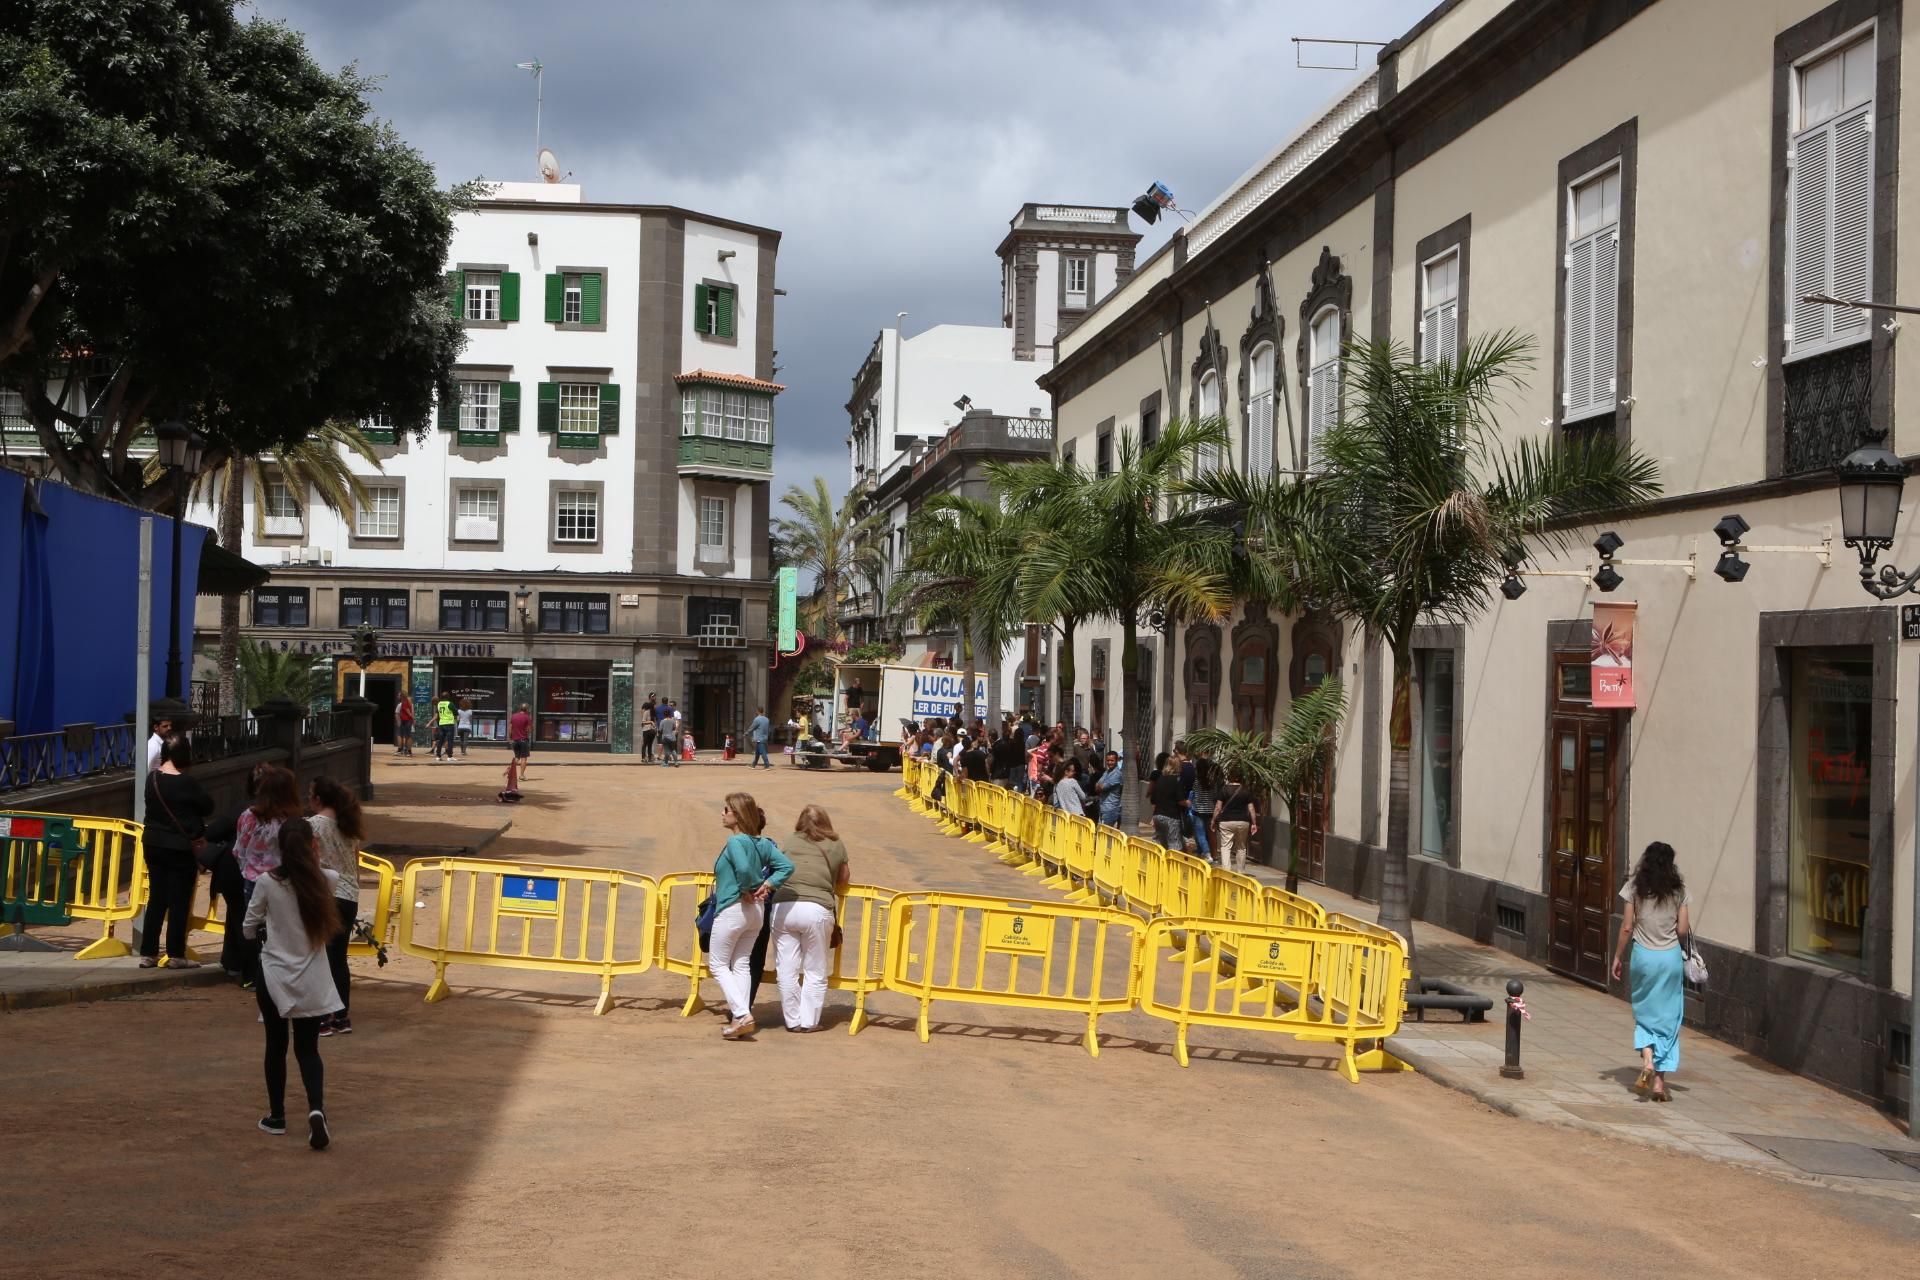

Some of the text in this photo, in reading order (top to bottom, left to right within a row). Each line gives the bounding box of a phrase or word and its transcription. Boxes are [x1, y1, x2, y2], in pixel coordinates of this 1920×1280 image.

[289, 596, 304, 604] ROUX
[344, 597, 407, 606] ACHATS ET VENTES
[471, 599, 479, 608] ET
[566, 602, 584, 610] HAUTE
[374, 642, 496, 657] NSATLANTIQUE
[922, 675, 984, 700] LUCLAA
[931, 703, 941, 714] DE
